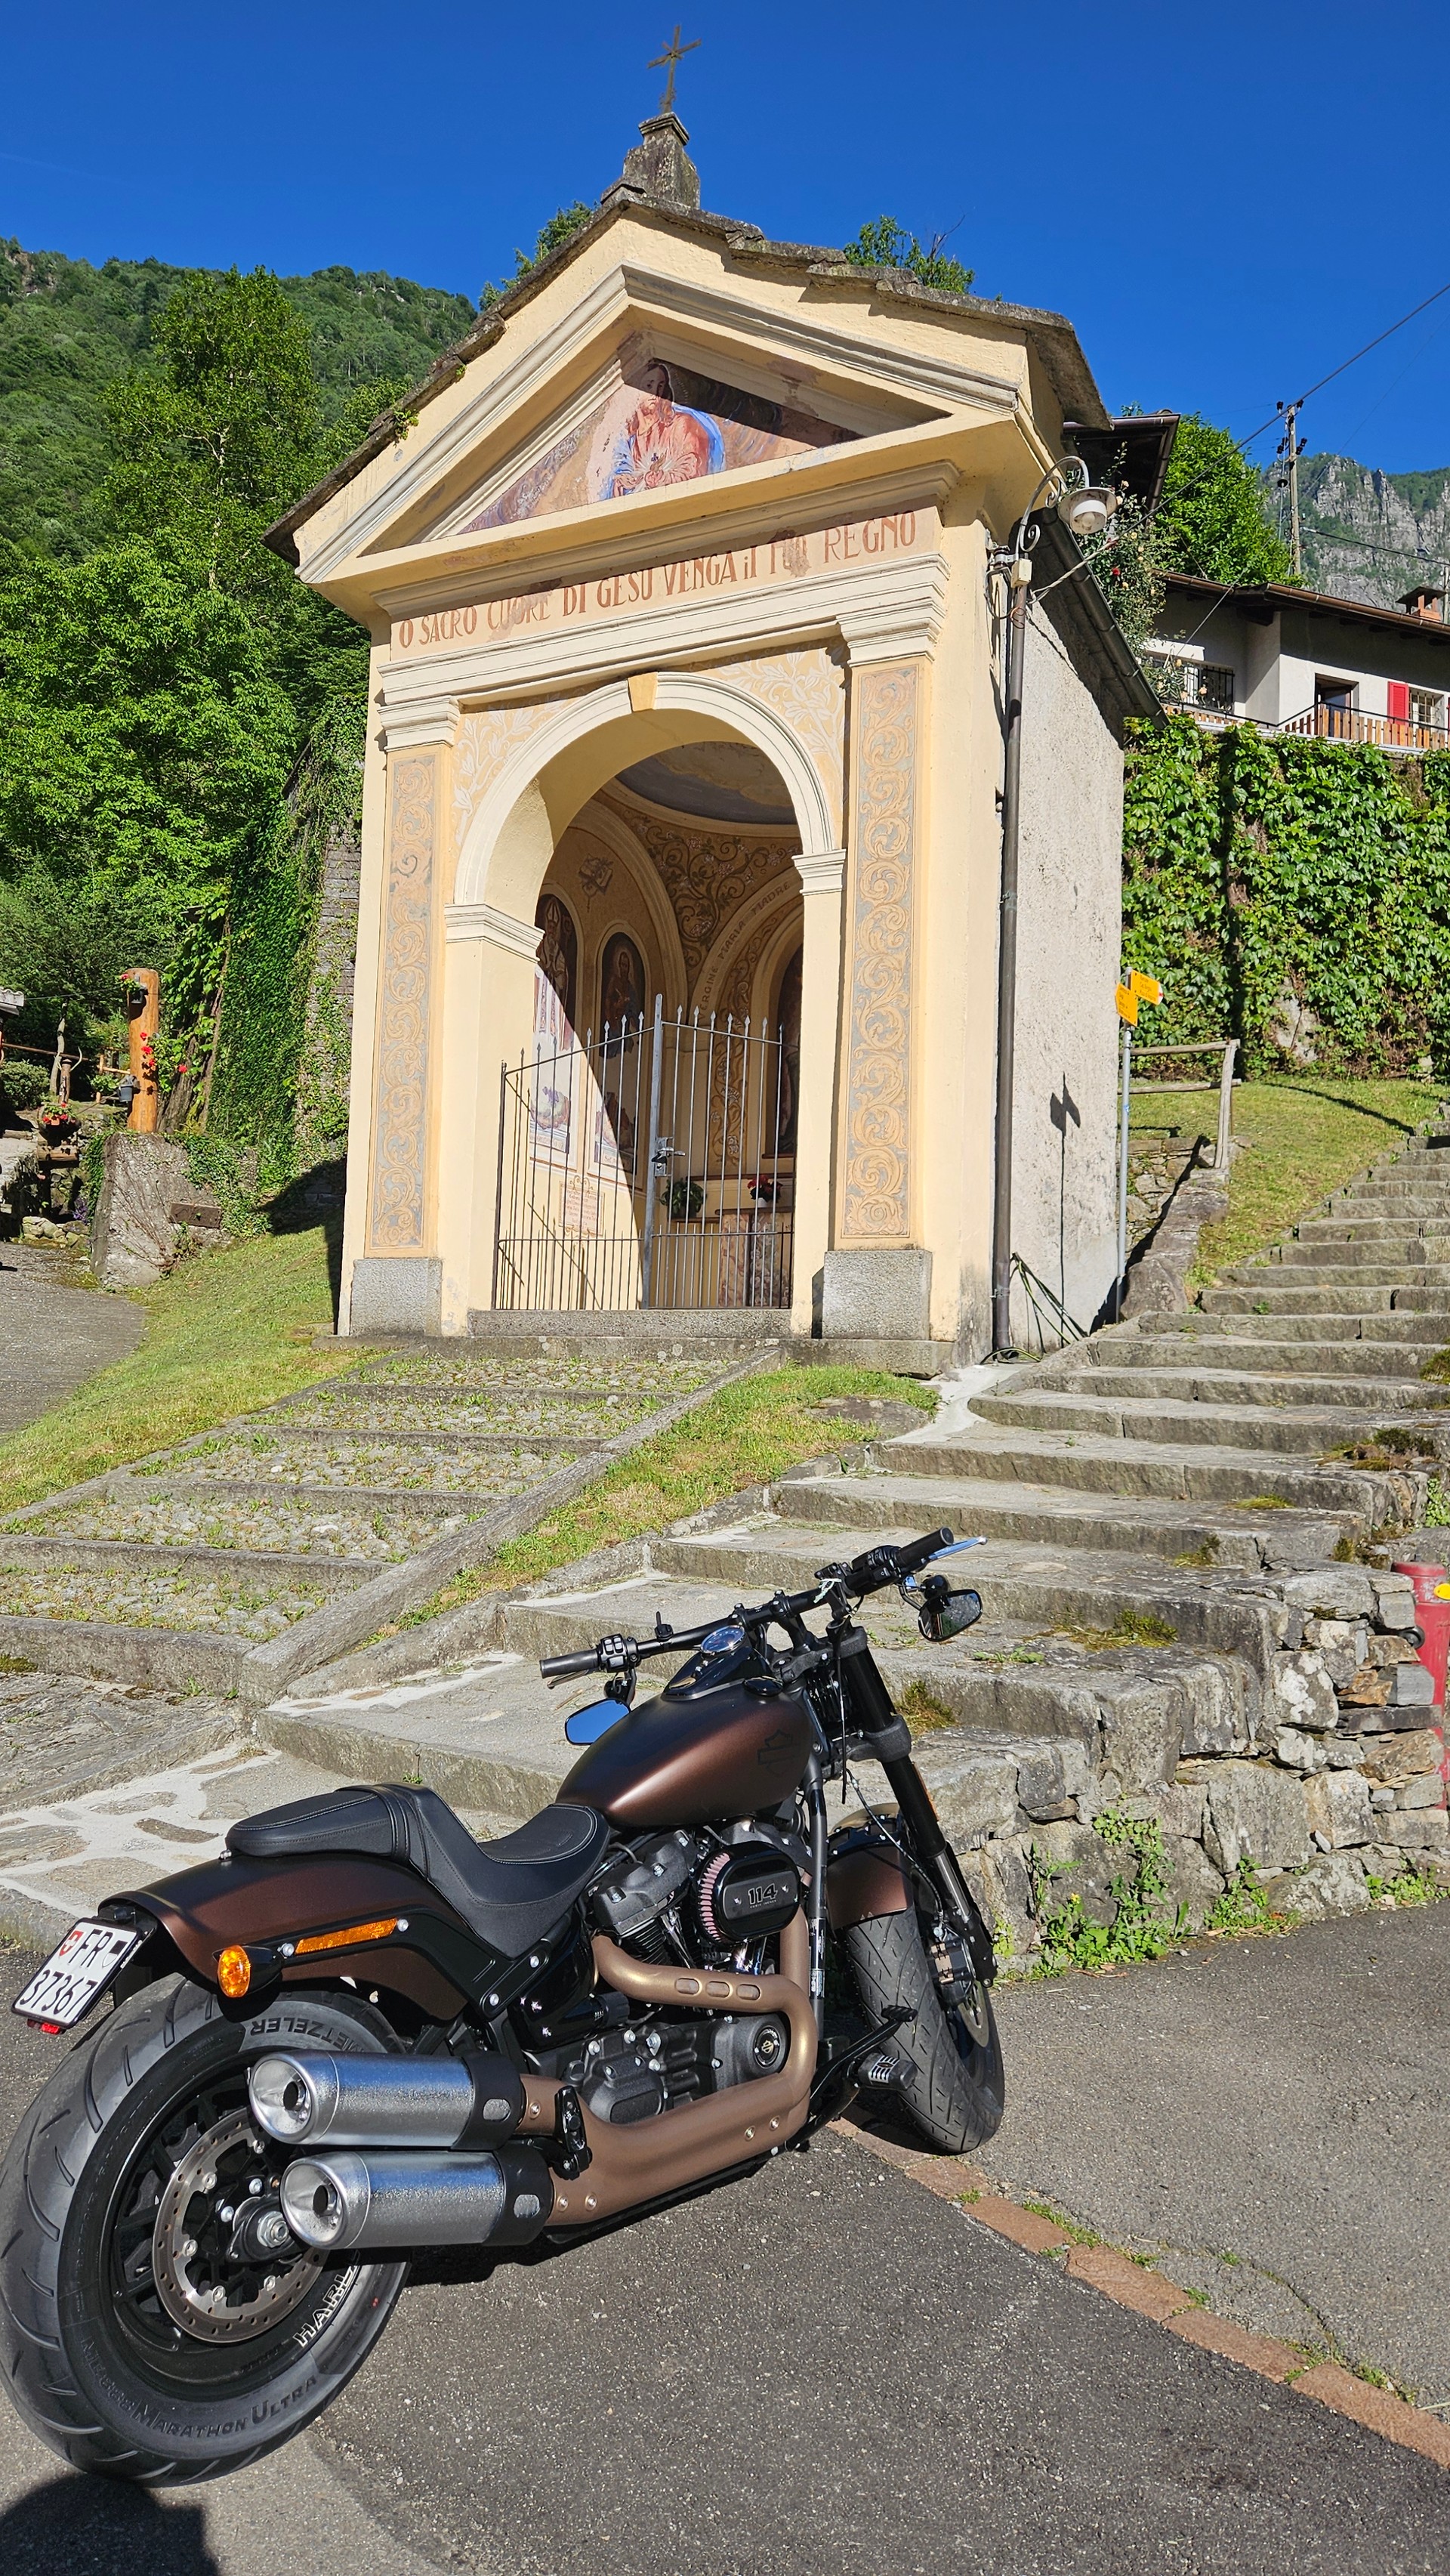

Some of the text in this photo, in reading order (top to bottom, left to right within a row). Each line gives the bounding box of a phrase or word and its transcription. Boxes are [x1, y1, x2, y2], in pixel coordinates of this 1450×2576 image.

[399, 619, 414, 648] O
[419, 606, 477, 645] SACRO
[562, 584, 586, 617] DI
[664, 551, 737, 596] VENGA
[824, 510, 916, 564] REGNO
[699, 881, 791, 1020] VERGINE MARIA MADRE
[748, 1883, 778, 1904] 114
[68, 1928, 114, 1969] FR
[20, 1969, 99, 2018] 37367
[251, 2377, 317, 2425] ULTRA
